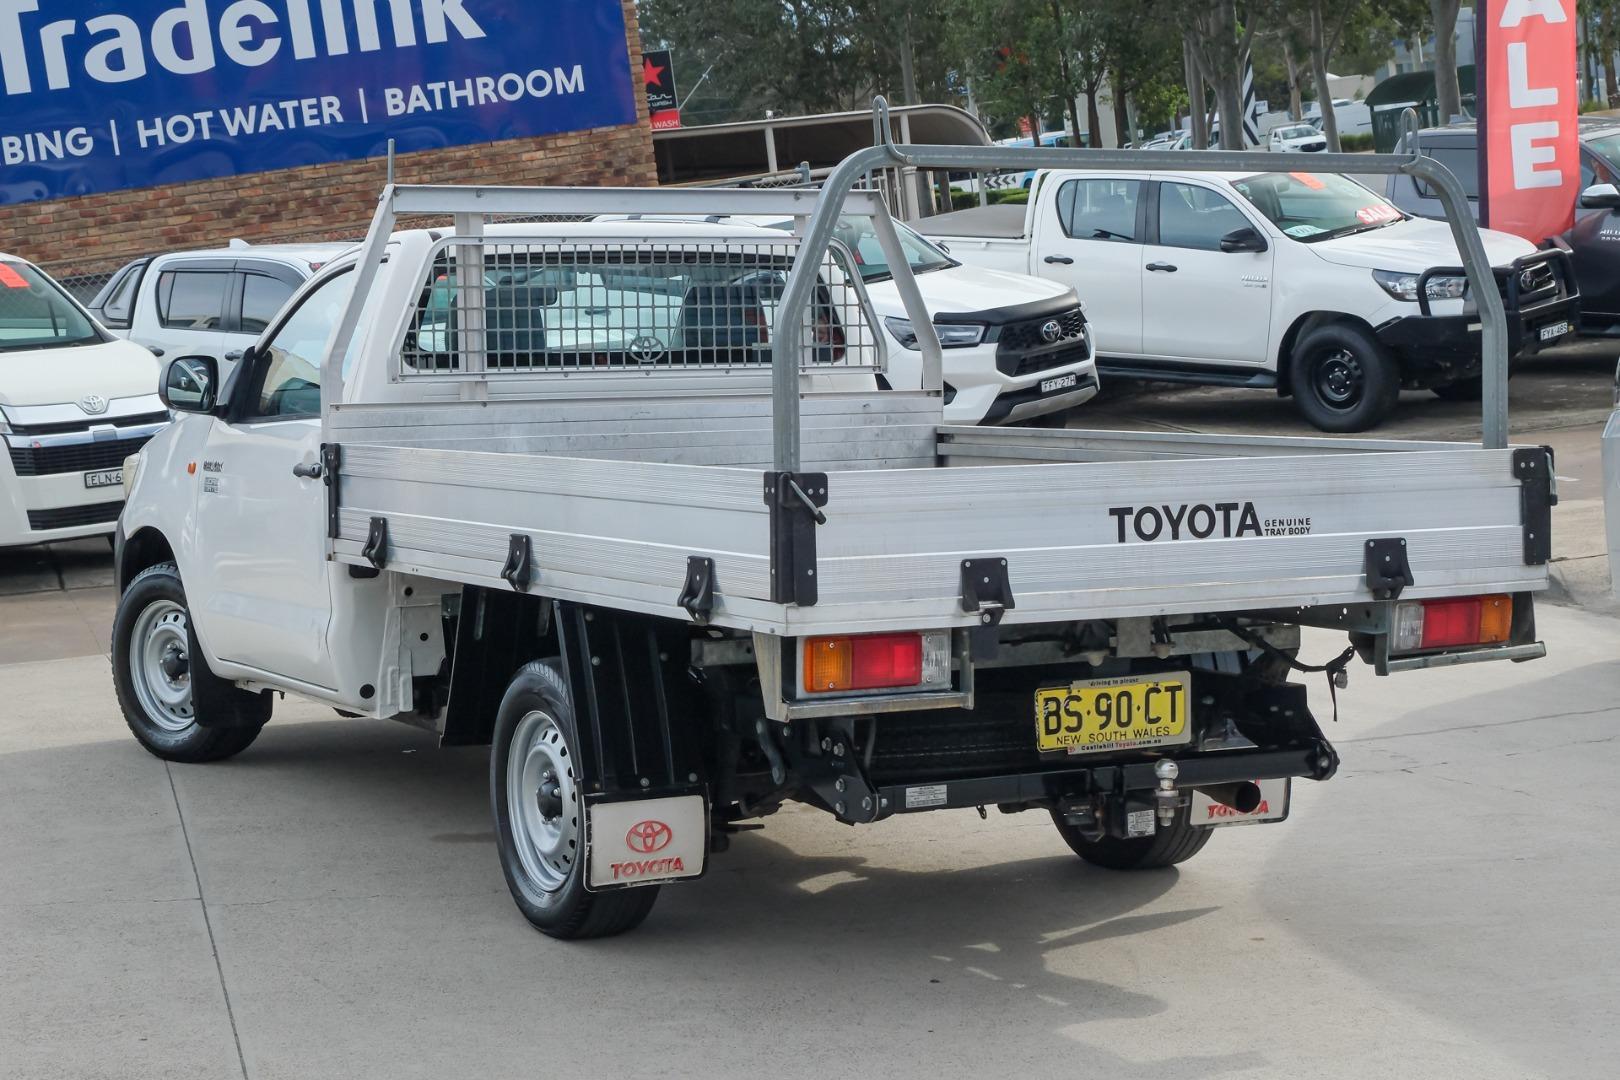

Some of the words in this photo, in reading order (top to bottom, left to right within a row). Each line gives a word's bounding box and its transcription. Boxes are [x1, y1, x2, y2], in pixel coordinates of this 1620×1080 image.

[137, 111, 213, 148] HOT
[219, 95, 344, 137] WATER
[384, 64, 585, 117] BATHROOM
[653, 119, 679, 129] WASH
[1109, 502, 1263, 543] TOYOTA
[1264, 517, 1311, 527] GENUINE
[1264, 528, 1286, 536] TRAY
[1288, 526, 1311, 535] BODY
[1056, 734, 1081, 746] NEW
[1089, 731, 1127, 743] SOUTH
[1133, 726, 1170, 739] WALES
[610, 857, 684, 880] TOYOTA
